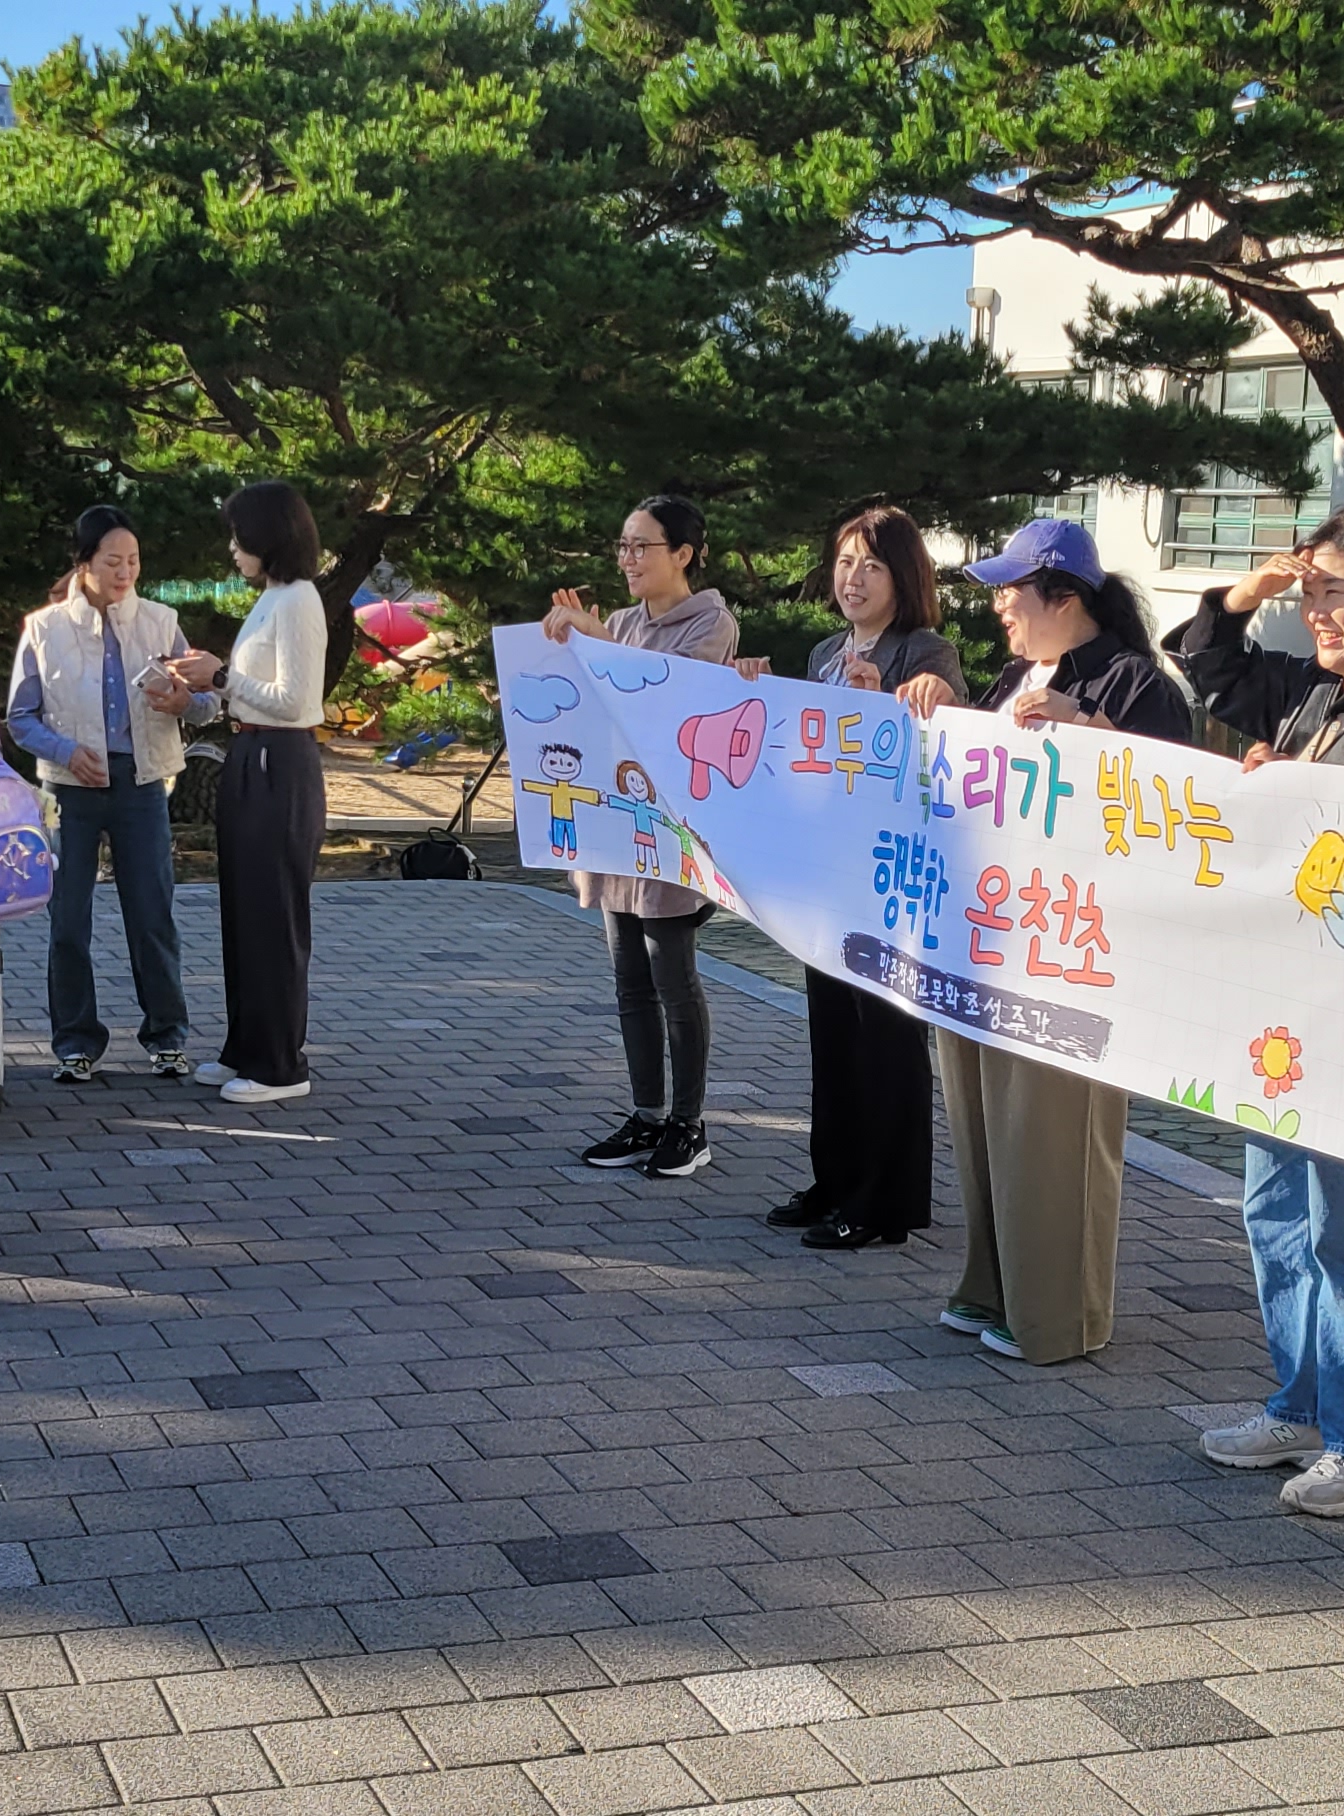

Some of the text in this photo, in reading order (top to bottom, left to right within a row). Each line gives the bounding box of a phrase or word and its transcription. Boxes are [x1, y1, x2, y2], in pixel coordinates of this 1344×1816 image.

[790, 708, 912, 802] 모두의
[1097, 747, 1234, 887] 빛나는
[873, 830, 1115, 987] 행복한 온천초
